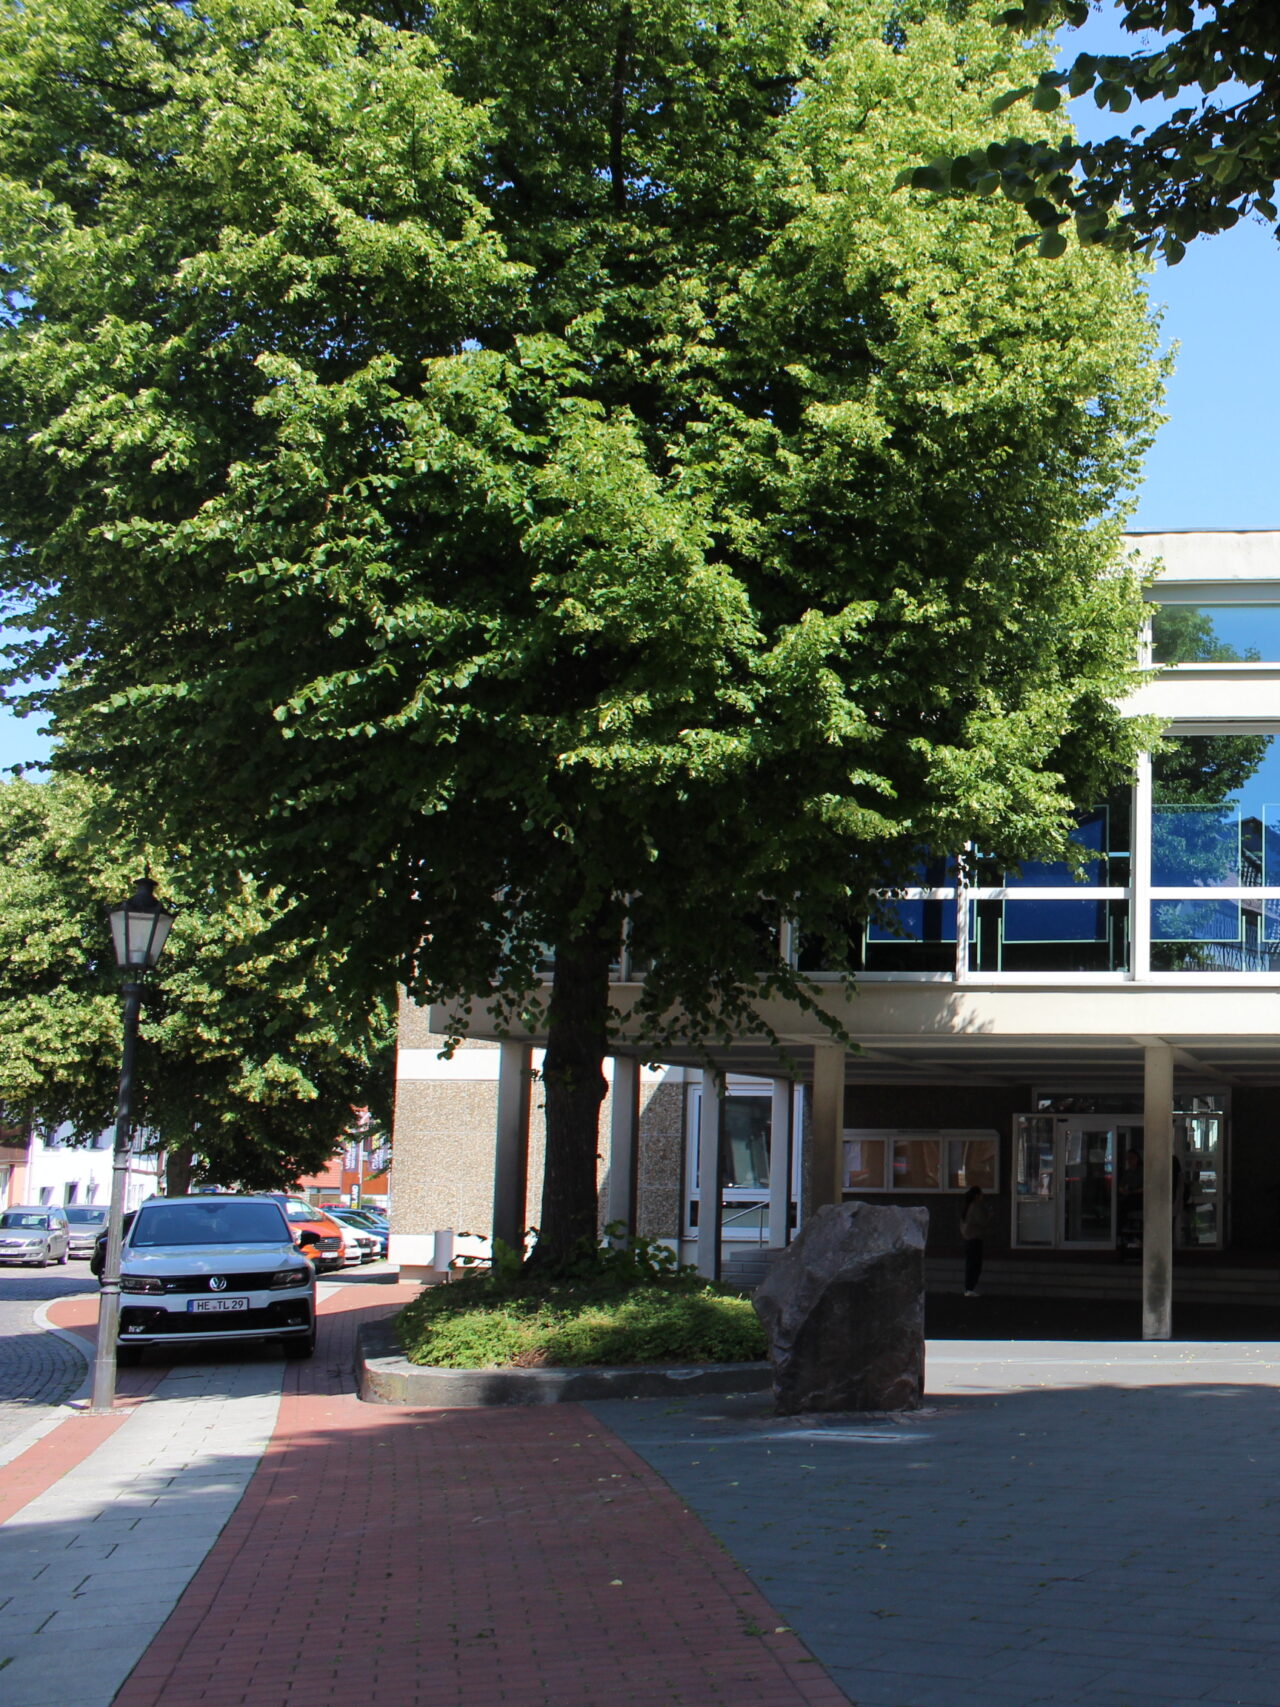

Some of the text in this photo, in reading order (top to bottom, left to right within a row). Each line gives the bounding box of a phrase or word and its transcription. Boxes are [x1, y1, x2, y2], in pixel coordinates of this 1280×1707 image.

[197, 1300, 244, 1311] HE TL 29
